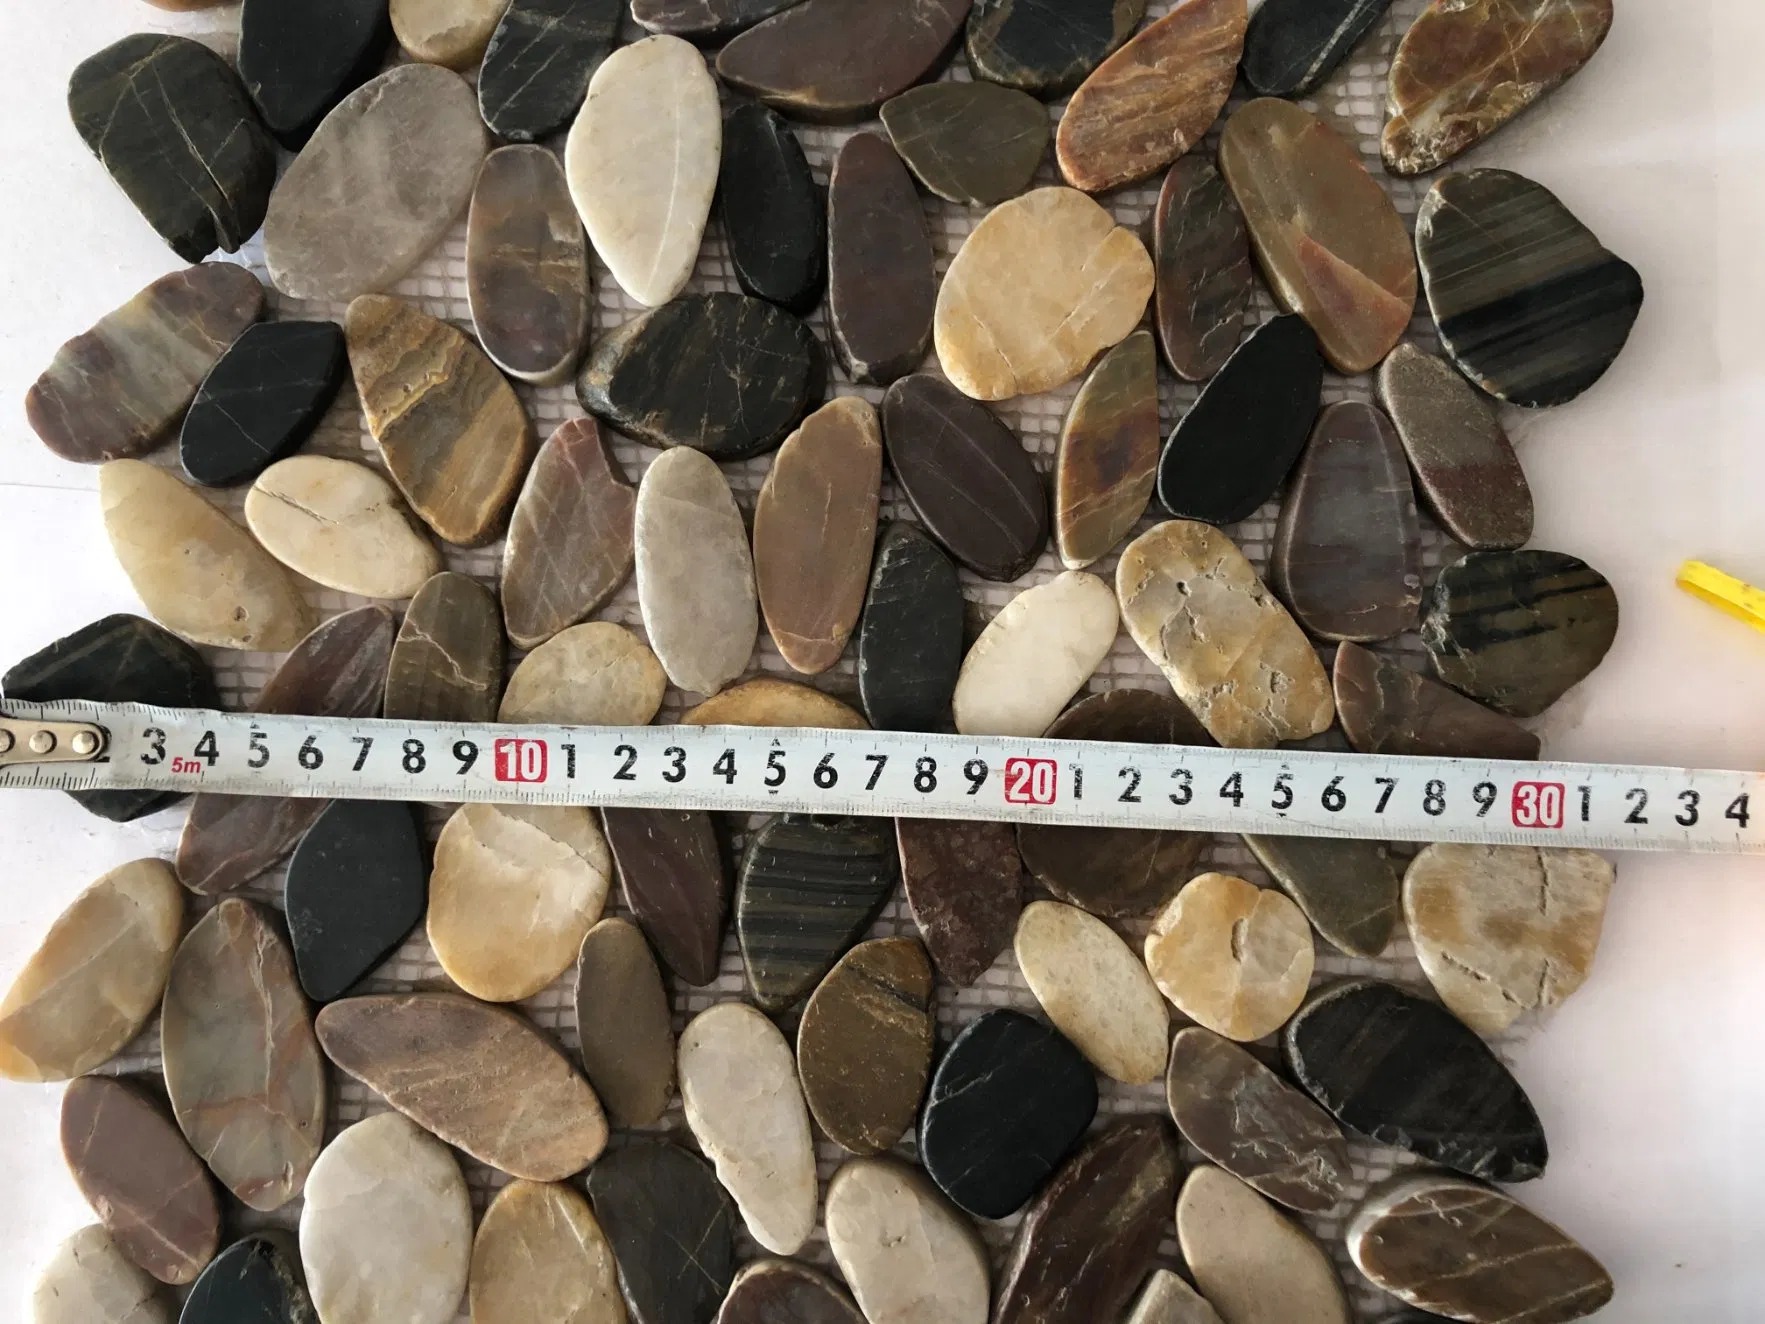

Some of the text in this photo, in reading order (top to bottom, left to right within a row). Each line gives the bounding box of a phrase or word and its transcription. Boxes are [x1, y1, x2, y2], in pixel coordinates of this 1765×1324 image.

[142, 727, 166, 765] 3
[193, 730, 219, 767] 4
[248, 732, 270, 768] 5
[298, 734, 324, 770] 6
[352, 737, 374, 771] 7
[401, 738, 427, 774] 8
[452, 740, 479, 775] 9
[500, 740, 542, 781] 10
[561, 743, 576, 779] 1
[613, 744, 638, 780] 2
[662, 746, 687, 783] 3
[712, 748, 738, 784] 4
[764, 750, 786, 786] 5
[813, 752, 838, 789] 6
[865, 754, 889, 790] 7
[913, 756, 938, 793] 8
[963, 758, 989, 795] 9
[1009, 760, 1055, 801] 20
[1069, 763, 1084, 800] 1
[1117, 766, 1142, 803] 2
[1168, 769, 1194, 805] 3
[1219, 771, 1245, 808] 4
[1271, 773, 1294, 809] 5
[1320, 775, 1347, 812] 6
[1374, 777, 1399, 814] 7
[1422, 779, 1447, 816] 8
[1472, 781, 1498, 818] 9
[1516, 785, 1561, 826] 30
[1577, 785, 1592, 821] 1
[1624, 788, 1650, 824] 2
[1675, 789, 1701, 826] 3
[1725, 792, 1751, 828] 4
[171, 757, 201, 774] 5m
